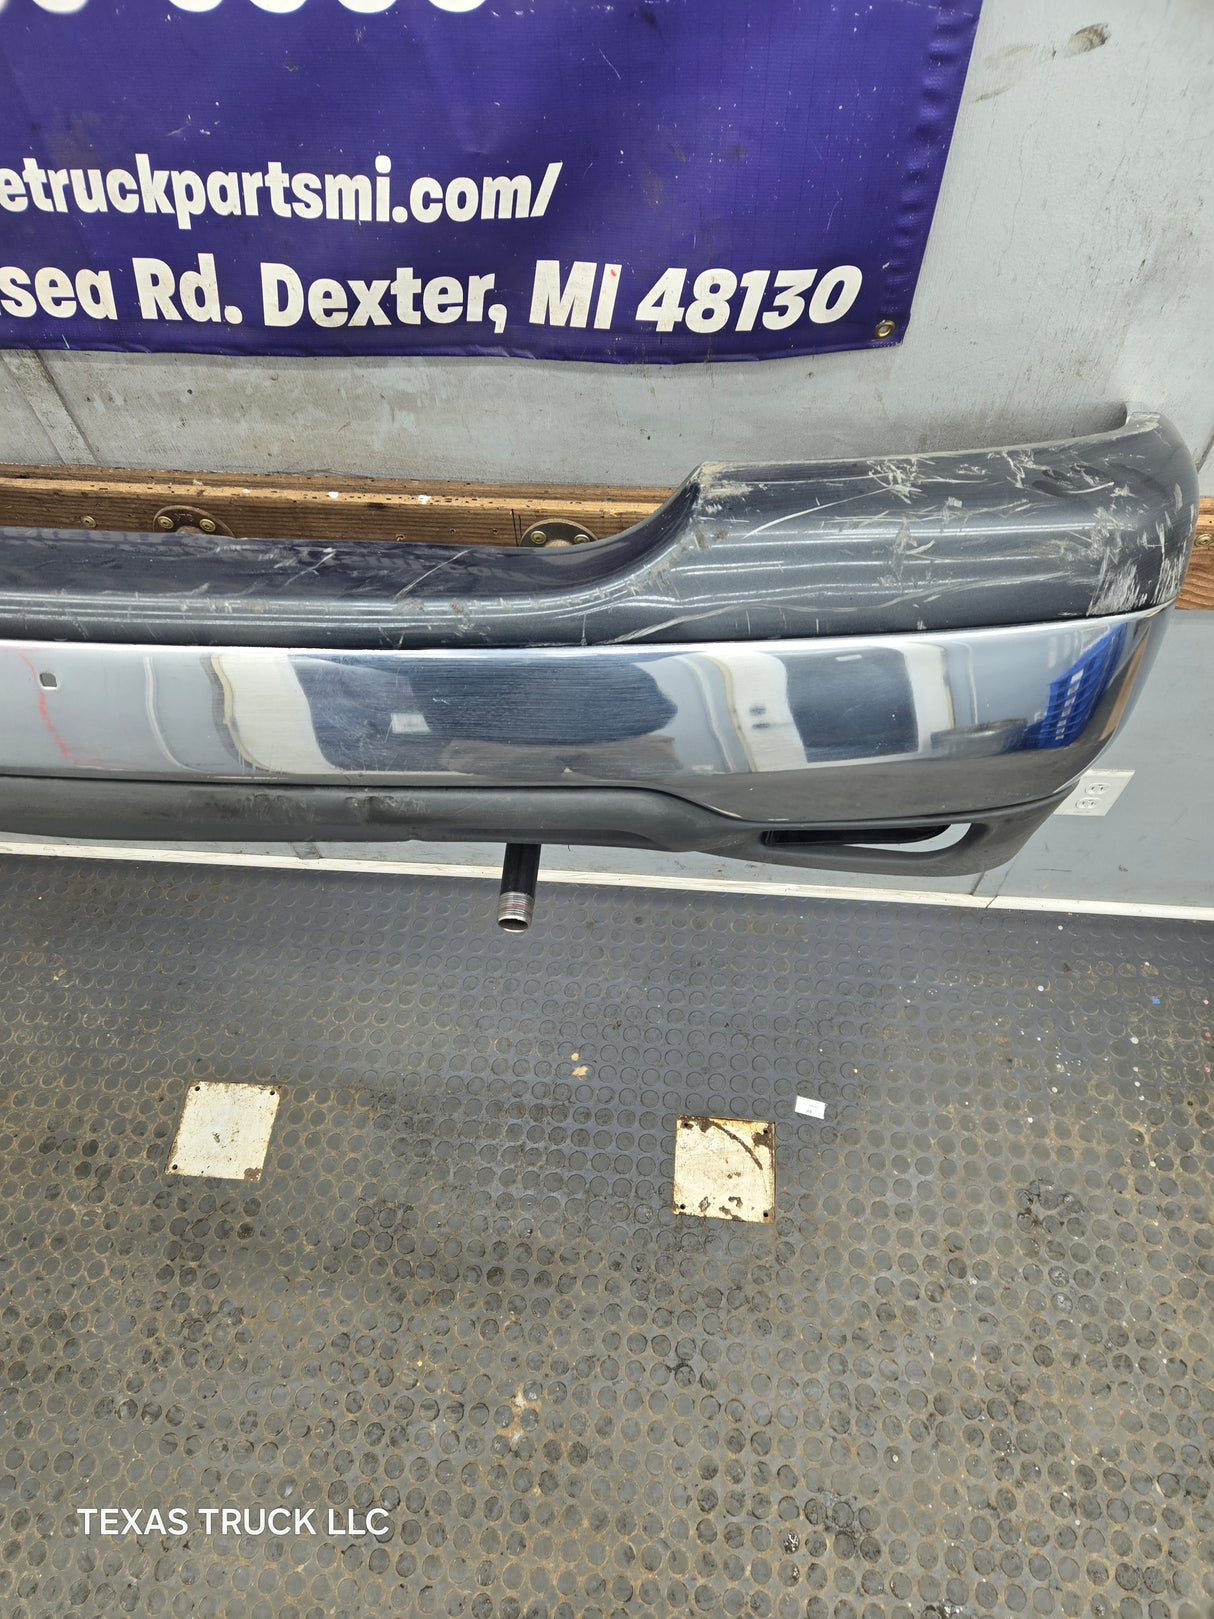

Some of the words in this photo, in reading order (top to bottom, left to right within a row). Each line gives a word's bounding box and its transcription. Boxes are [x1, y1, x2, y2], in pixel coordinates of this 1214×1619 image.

[0, 153, 564, 230] etruckpartsmi.com/
[131, 252, 243, 325] Rd.
[260, 262, 507, 334] Dexter,
[528, 259, 623, 330] MI
[635, 265, 863, 334] 48130
